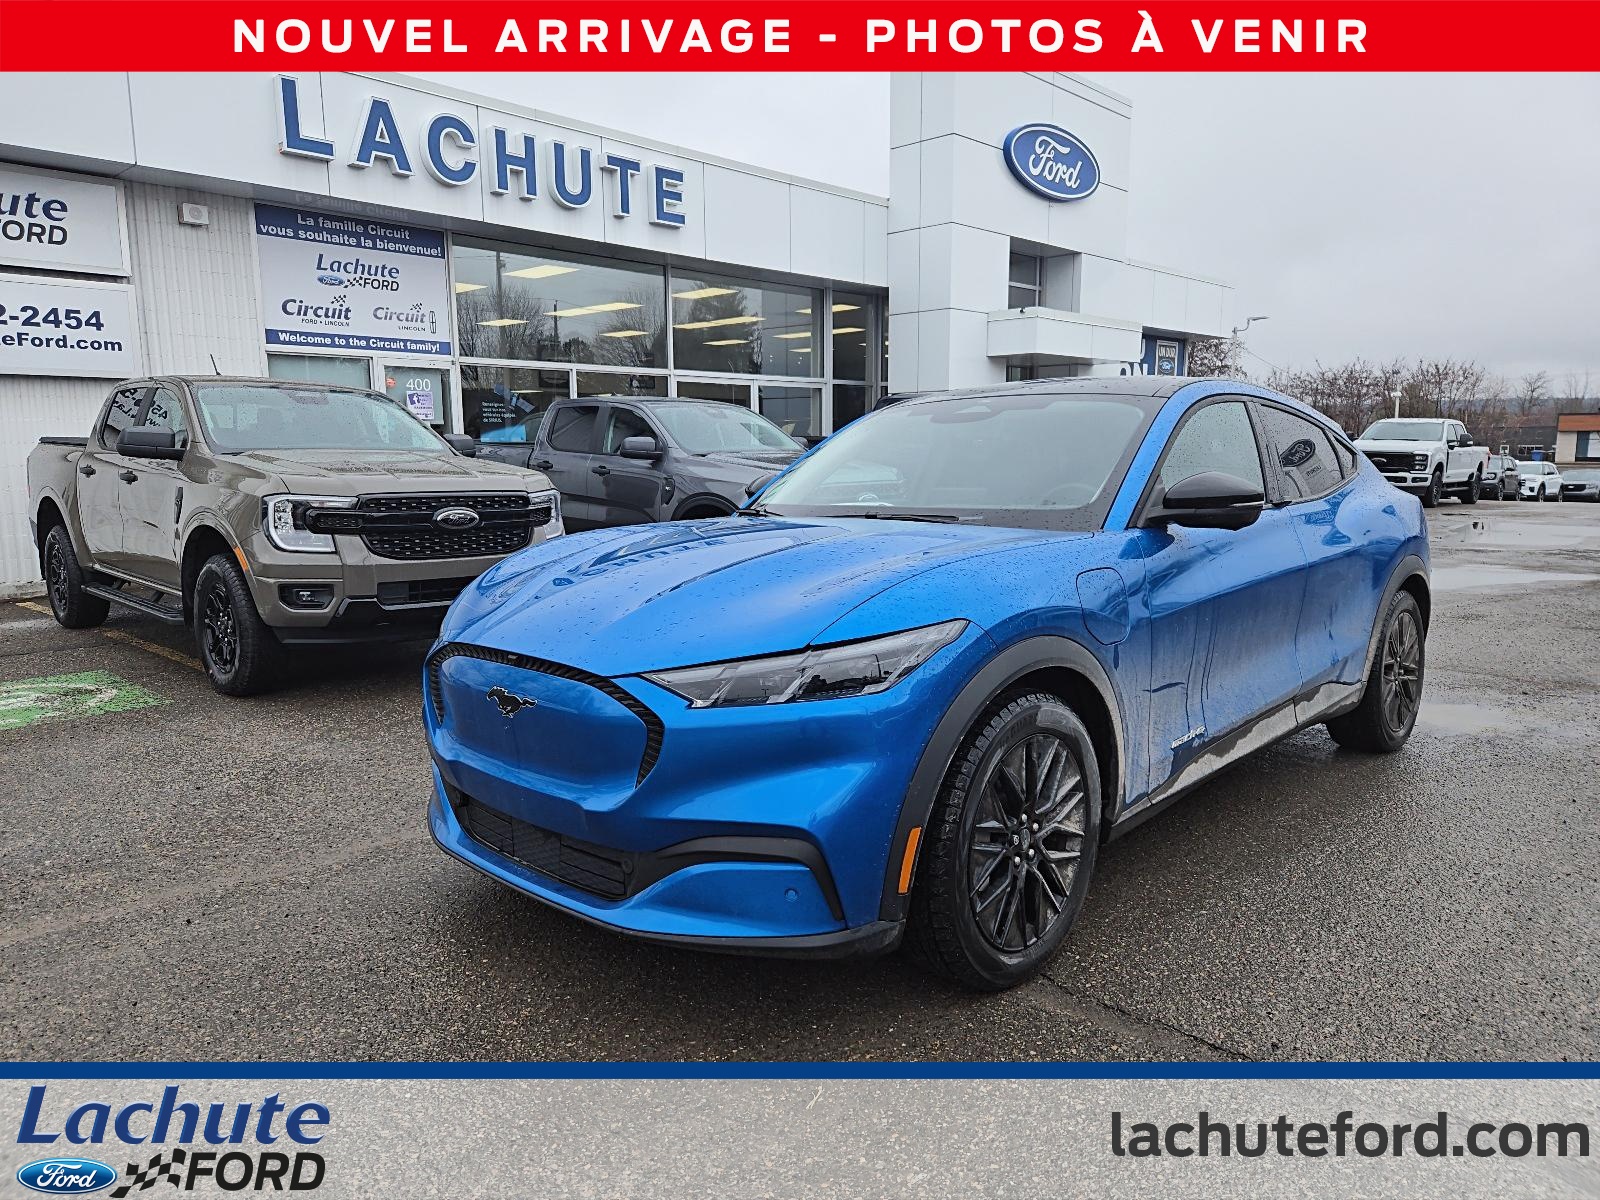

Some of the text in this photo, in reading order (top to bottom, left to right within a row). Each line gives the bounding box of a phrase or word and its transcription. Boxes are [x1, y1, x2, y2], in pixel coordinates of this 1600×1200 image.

[273, 74, 687, 229] LACHUTE
[1029, 136, 1082, 188] Ford
[0, 219, 68, 245] ORD
[297, 213, 410, 240] La famille Circuit
[260, 223, 442, 257] vous souhaite la bienvenue!
[316, 253, 400, 279] Lachute
[363, 277, 400, 292] FORD
[281, 298, 352, 321] Circuit
[372, 306, 426, 324] Circuit
[324, 319, 350, 327] LINCOLN
[278, 332, 440, 352] Welcome to the Circuit family!
[406, 378, 431, 391] 400
